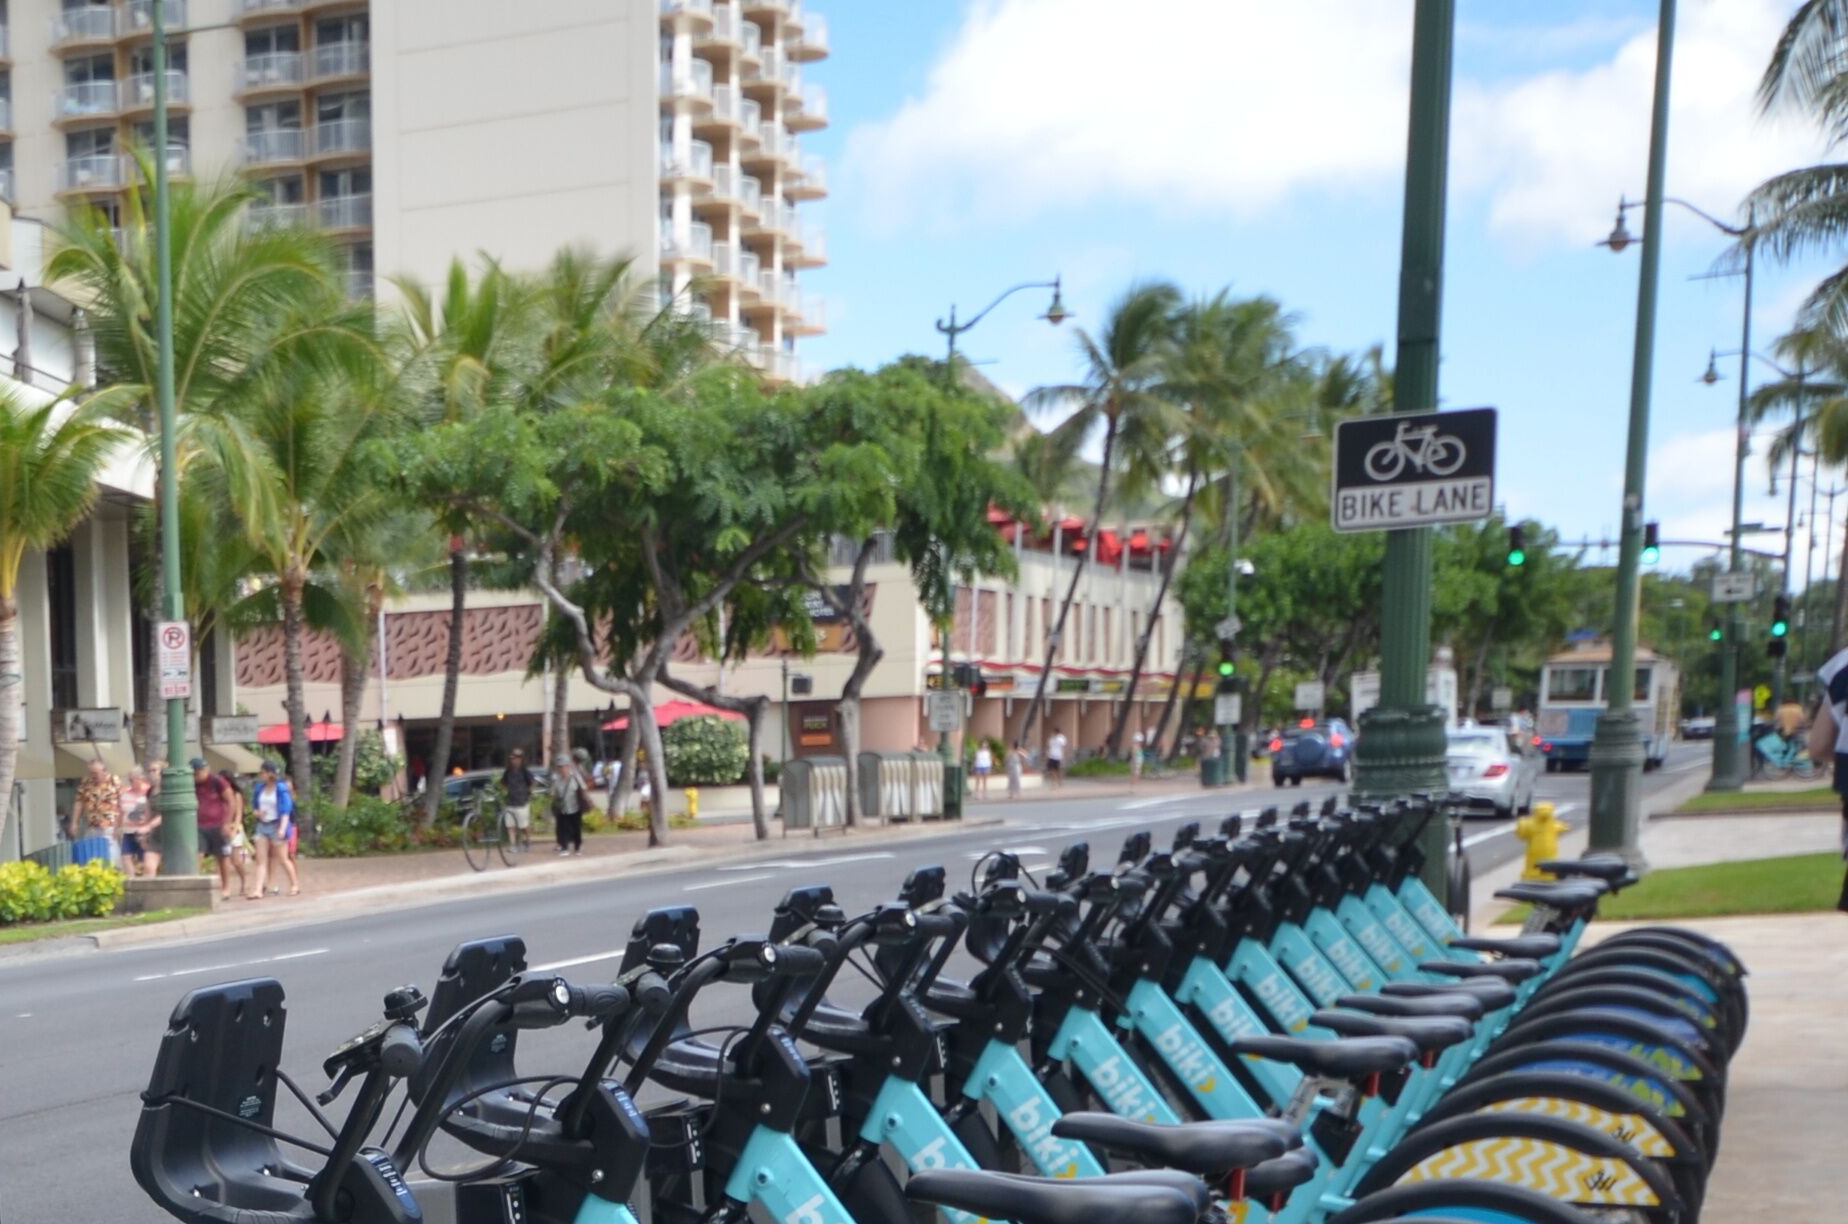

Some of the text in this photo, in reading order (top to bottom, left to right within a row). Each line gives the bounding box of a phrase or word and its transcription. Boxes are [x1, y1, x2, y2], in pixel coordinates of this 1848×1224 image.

[1342, 483, 1487, 521] BIKE LANE
[1156, 1023, 1217, 1083] biki
